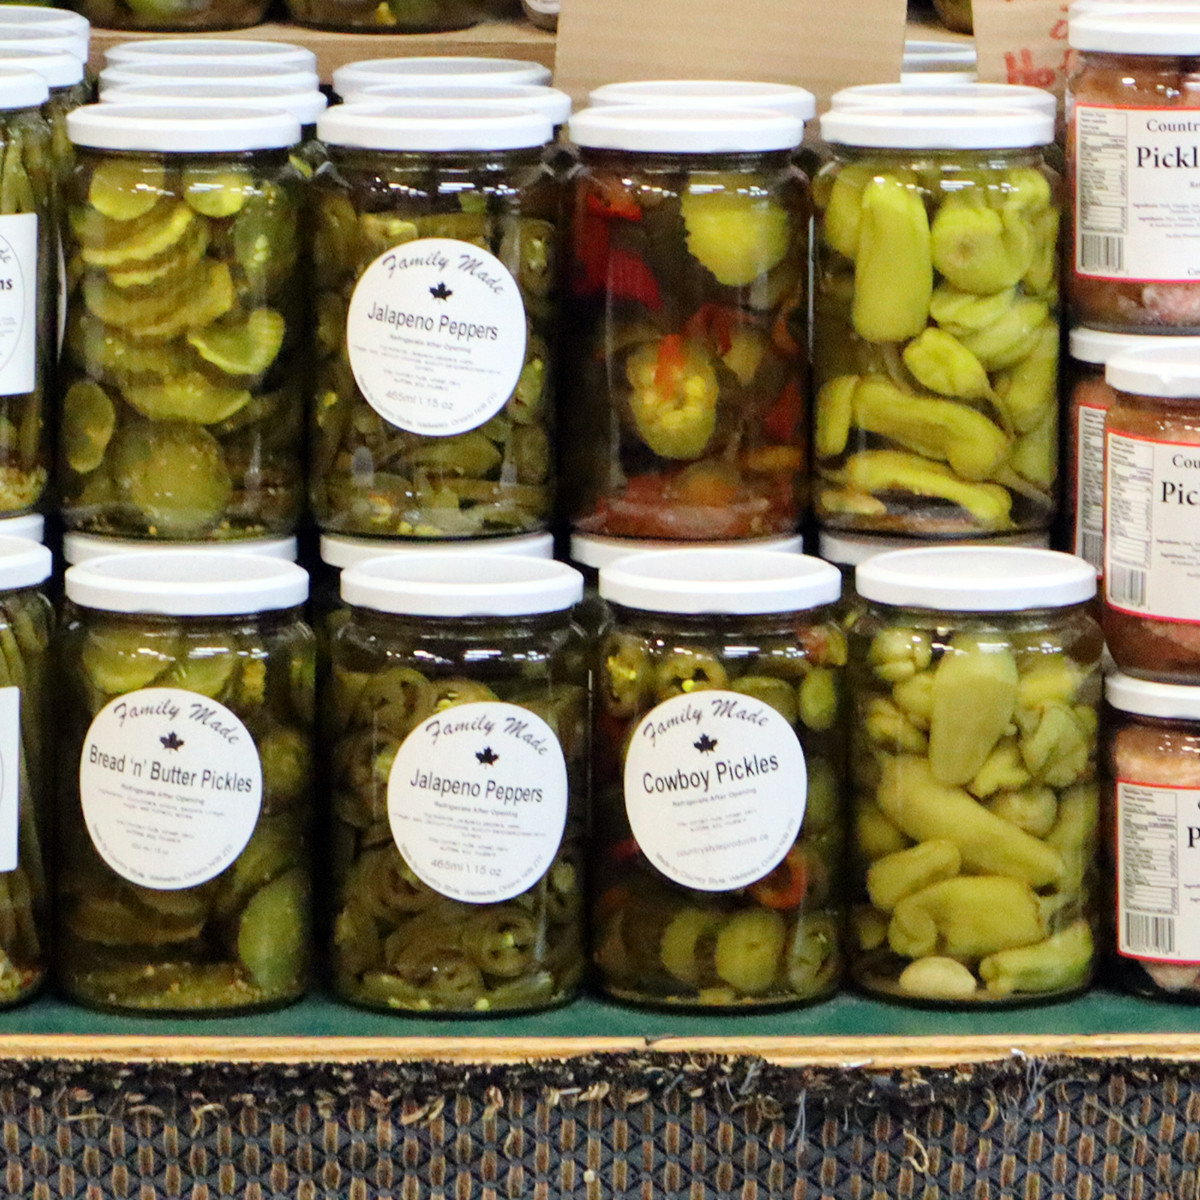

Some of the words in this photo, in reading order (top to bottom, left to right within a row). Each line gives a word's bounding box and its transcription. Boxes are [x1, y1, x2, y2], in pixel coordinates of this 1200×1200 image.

[382, 250, 450, 279] Family
[458, 254, 505, 295] Made
[367, 301, 435, 331] Jalapeno
[438, 314, 499, 343] Peppers
[113, 698, 180, 728] Family
[188, 702, 240, 745] Made
[425, 714, 495, 745] Family
[504, 716, 549, 756] Made
[642, 703, 704, 747] Family
[711, 699, 769, 727] Made
[89, 744, 125, 773] Bread
[150, 760, 197, 787] Butter
[201, 768, 252, 793] Pickles
[410, 769, 480, 798] Jalapeno
[485, 779, 543, 806] Peppers
[642, 768, 710, 794] Cowboy
[715, 754, 779, 784] Pickles
